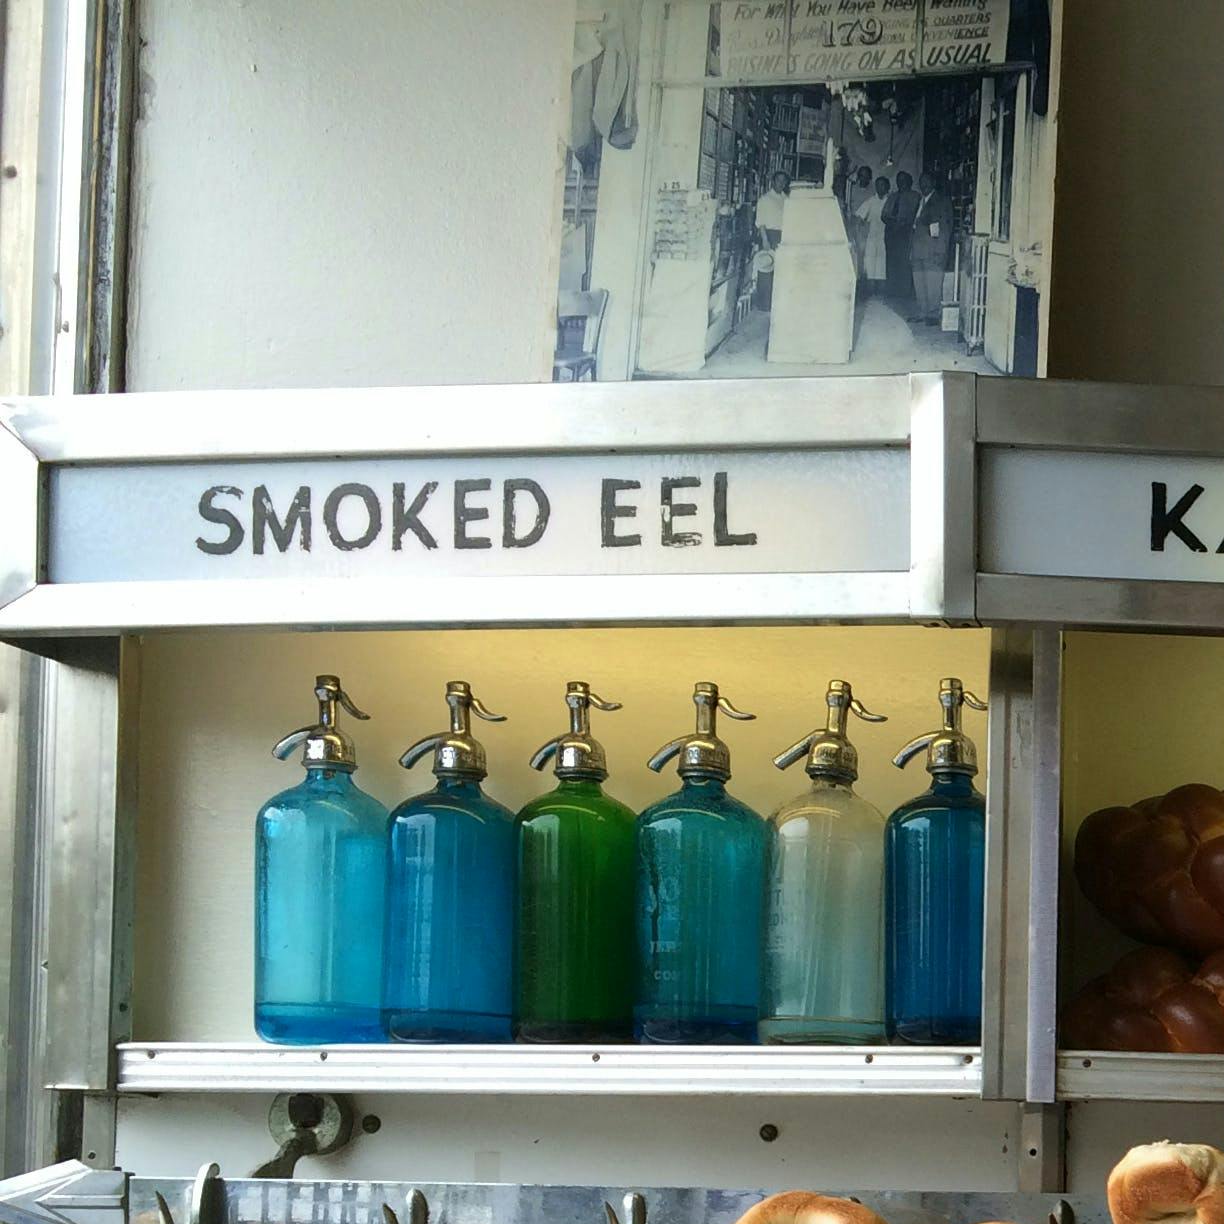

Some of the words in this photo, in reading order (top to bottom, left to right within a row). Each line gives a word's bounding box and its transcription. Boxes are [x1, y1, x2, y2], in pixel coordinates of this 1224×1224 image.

[822, 18, 884, 48] 179
[858, 49, 881, 70] ON
[926, 43, 991, 66] USUAL
[196, 477, 551, 555] SMOKED
[601, 471, 758, 549] EEL
